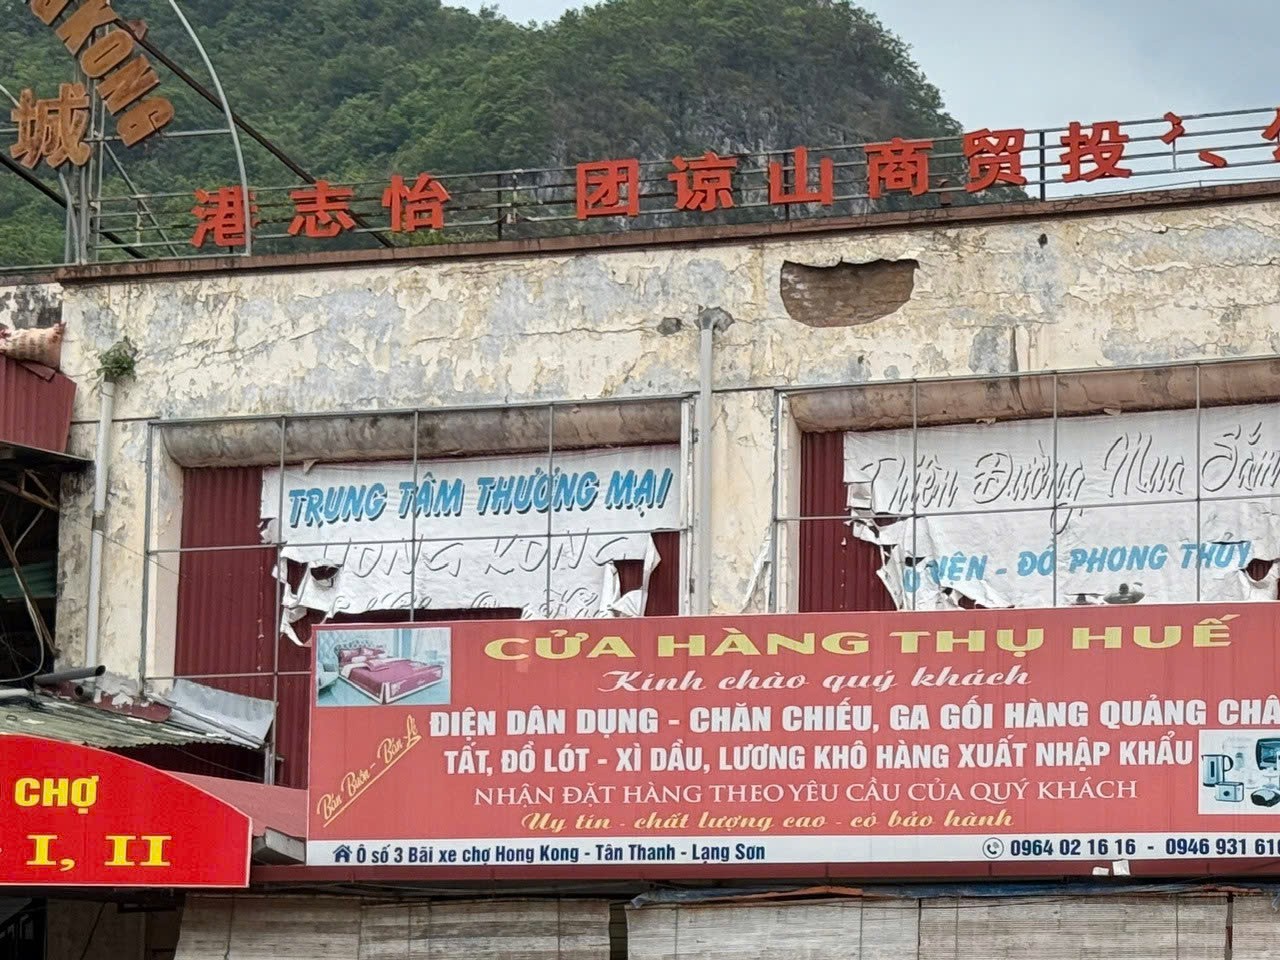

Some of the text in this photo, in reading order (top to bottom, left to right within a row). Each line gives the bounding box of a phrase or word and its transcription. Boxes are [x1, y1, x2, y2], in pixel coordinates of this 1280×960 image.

[10, 82, 91, 169] 城
[288, 467, 674, 528] TRUNG TÂM THƯƠNG MẠI
[861, 453, 959, 511] Thiên
[974, 439, 1086, 534] Đường
[1104, 431, 1186, 498] Mua
[1069, 543, 1169, 574] PHONG
[484, 613, 1241, 661] CỬA HÀNG THỤ HUẾ
[597, 664, 1032, 694] Kính chào quý khách
[429, 708, 496, 741] ĐIỆN
[507, 705, 566, 736] DÂN
[576, 707, 659, 739] DỤNG
[689, 701, 772, 733] CHĂN
[781, 696, 880, 735] CHIẾU,
[889, 703, 929, 731] GA
[939, 694, 994, 730] GỐI
[1004, 698, 1089, 730] HÀNG
[1100, 693, 1207, 731] QUẢNG
[444, 729, 1193, 776] TẤT, ĐỒ LÓT XÌ DẦU, LƯƠNG KHÔ HÀNG XUẤT NHẬP KHẨU
[14, 775, 100, 815] CHỢ
[474, 776, 1138, 809] NHẬN ĐẶT HÀNG THEO YÊU CẦU CỦA QUÝ KHÁCH
[520, 809, 1014, 833] Uy tín chất lượng cao có bảo hành
[104, 835, 172, 867] II
[356, 843, 367, 862] Ô
[371, 843, 391, 862] số
[394, 847, 404, 862] 3
[408, 843, 433, 862] Bãi
[436, 848, 458, 862] xe
[462, 844, 490, 864] chợ
[495, 845, 536, 866] Hong
[539, 844, 579, 866] Kong
[595, 843, 624, 861] Tân
[628, 844, 677, 861] Thanh
[691, 844, 731, 864] Lạng
[735, 843, 766, 860] Sơn
[1010, 839, 1054, 856] 0964
[1059, 839, 1081, 856] 02
[1085, 839, 1109, 856] 16
[1114, 839, 1137, 855] 16
[1165, 838, 1210, 856] 0946
[1215, 838, 1246, 855] 931
